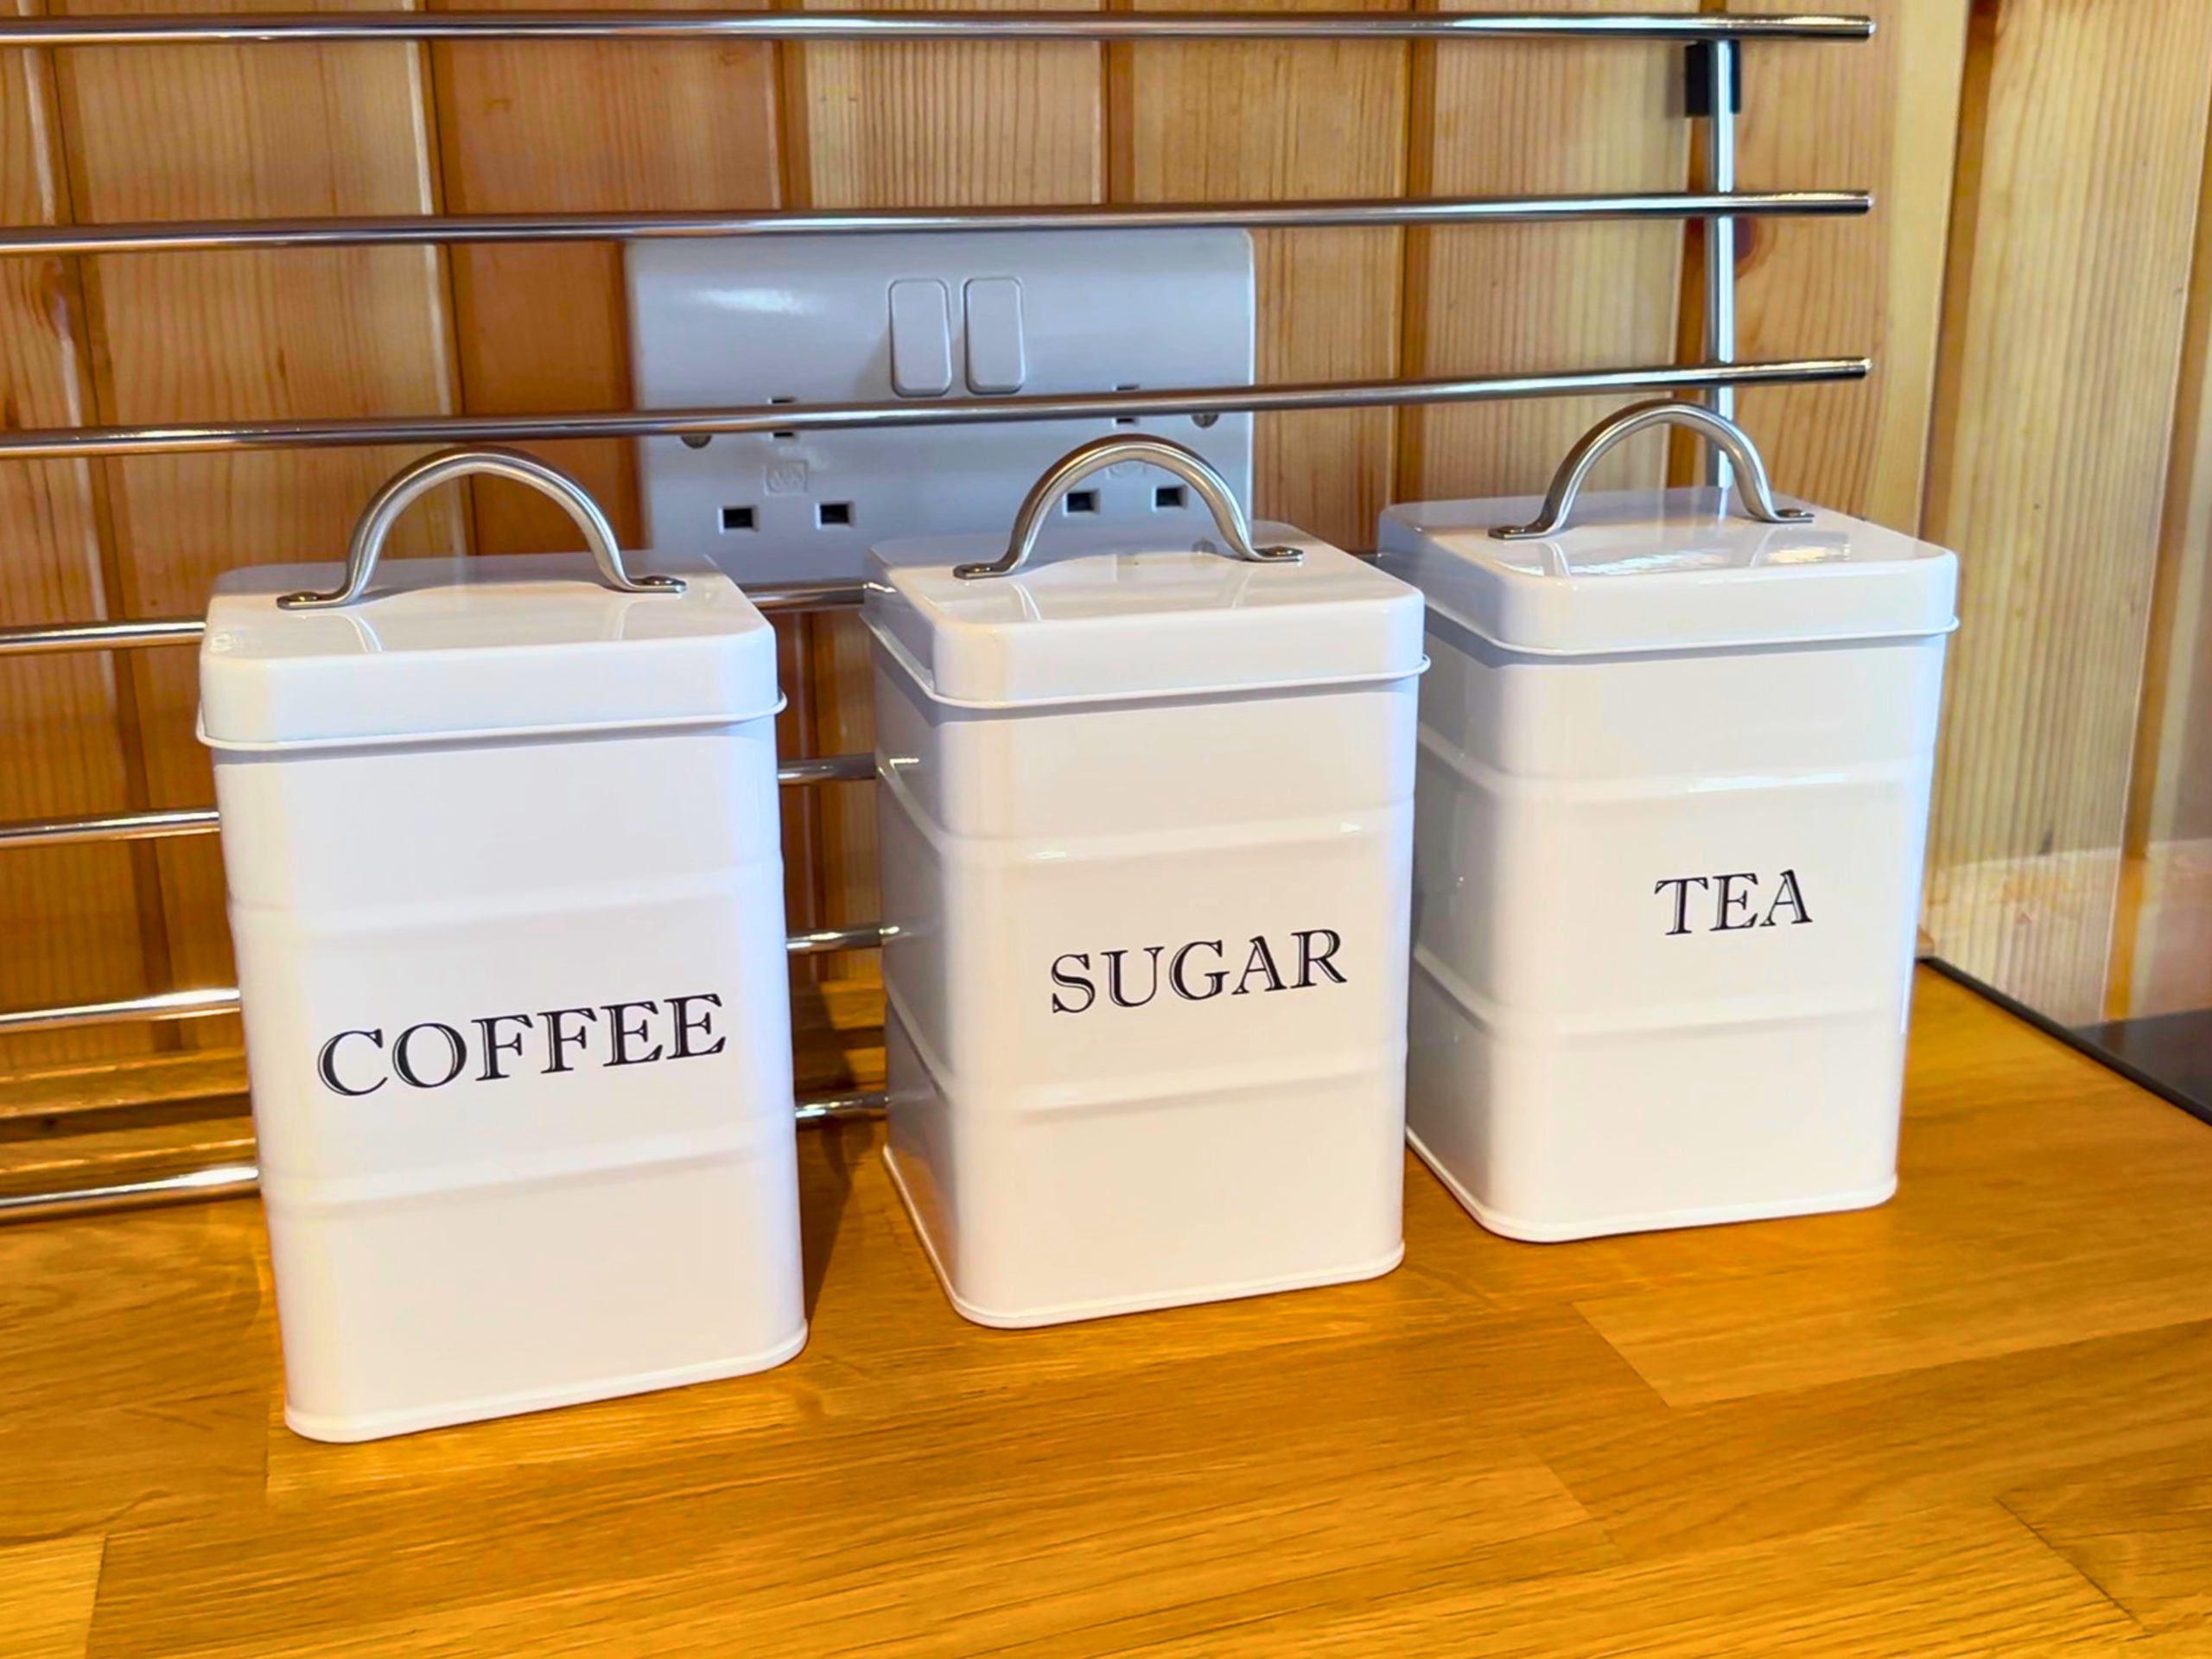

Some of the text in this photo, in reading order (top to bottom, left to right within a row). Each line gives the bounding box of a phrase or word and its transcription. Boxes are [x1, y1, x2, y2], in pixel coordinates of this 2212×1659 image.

[1654, 868, 1813, 936] TEA
[1051, 929, 1348, 1014] SUGAR
[317, 993, 726, 1097] COFFEE
